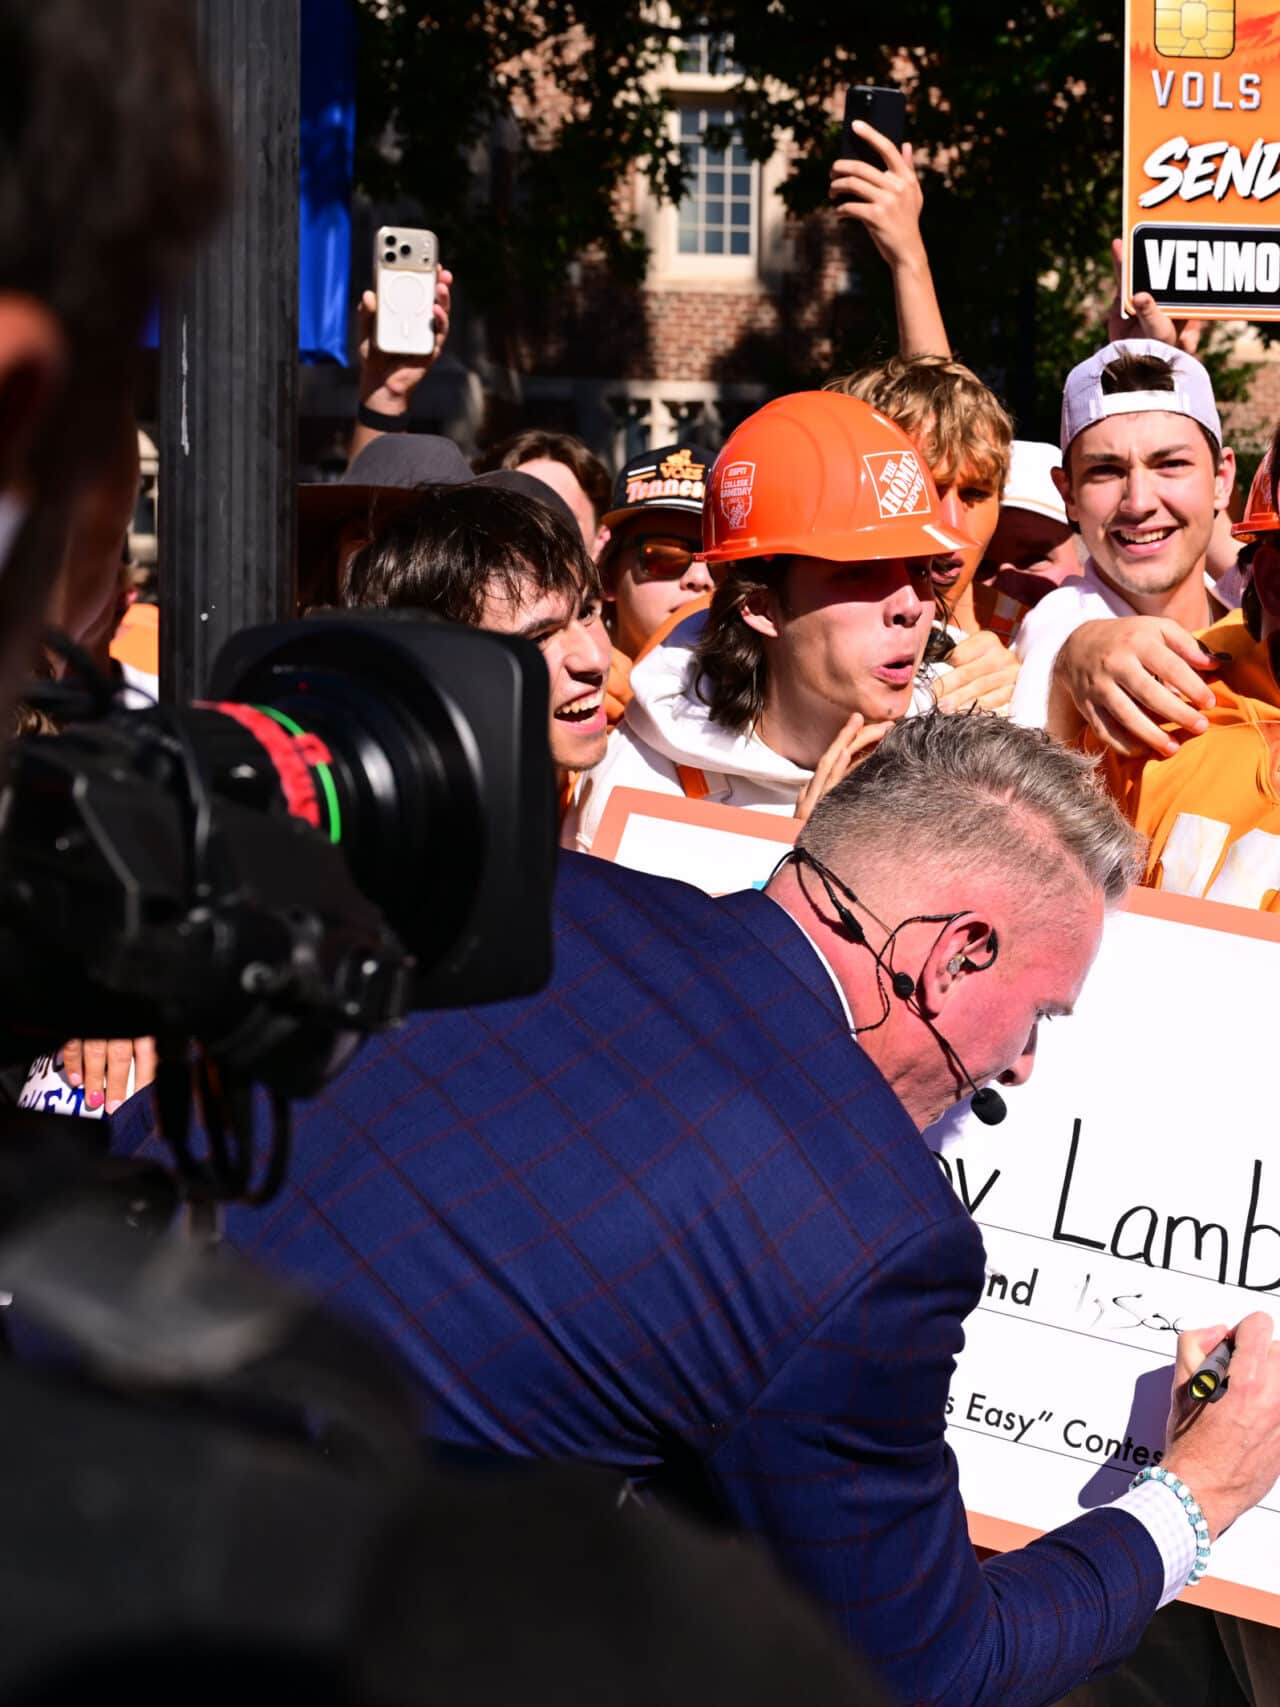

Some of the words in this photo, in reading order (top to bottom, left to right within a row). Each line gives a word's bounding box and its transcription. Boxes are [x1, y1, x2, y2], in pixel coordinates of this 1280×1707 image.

[1151, 69, 1261, 111] VOLS
[879, 459, 898, 484] THE
[880, 452, 919, 515] HOME
